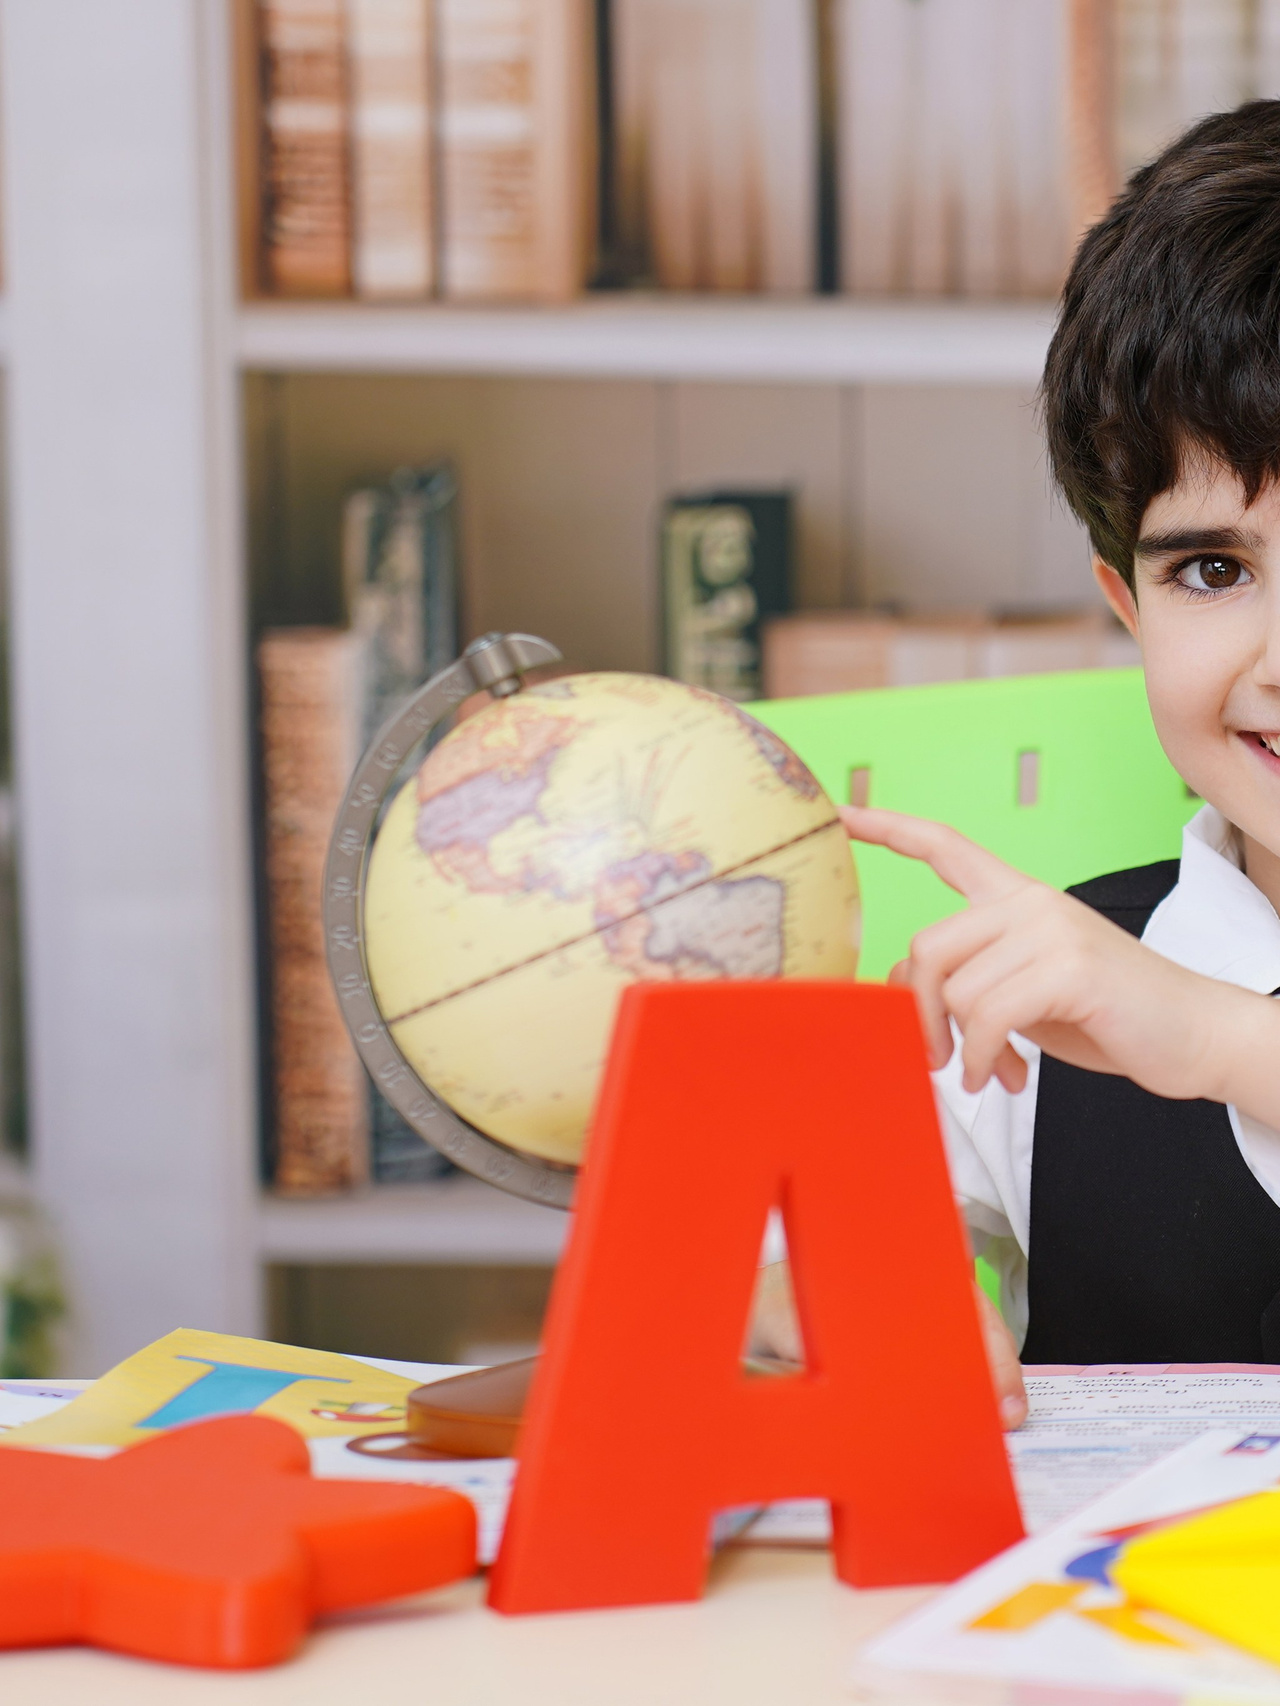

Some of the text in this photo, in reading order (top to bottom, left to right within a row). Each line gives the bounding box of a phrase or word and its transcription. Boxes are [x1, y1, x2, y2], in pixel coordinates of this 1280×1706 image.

[331, 924, 355, 950] 20
[338, 972, 363, 999] 10
[355, 1022, 380, 1043] 0
[486, 978, 1027, 1616] A
